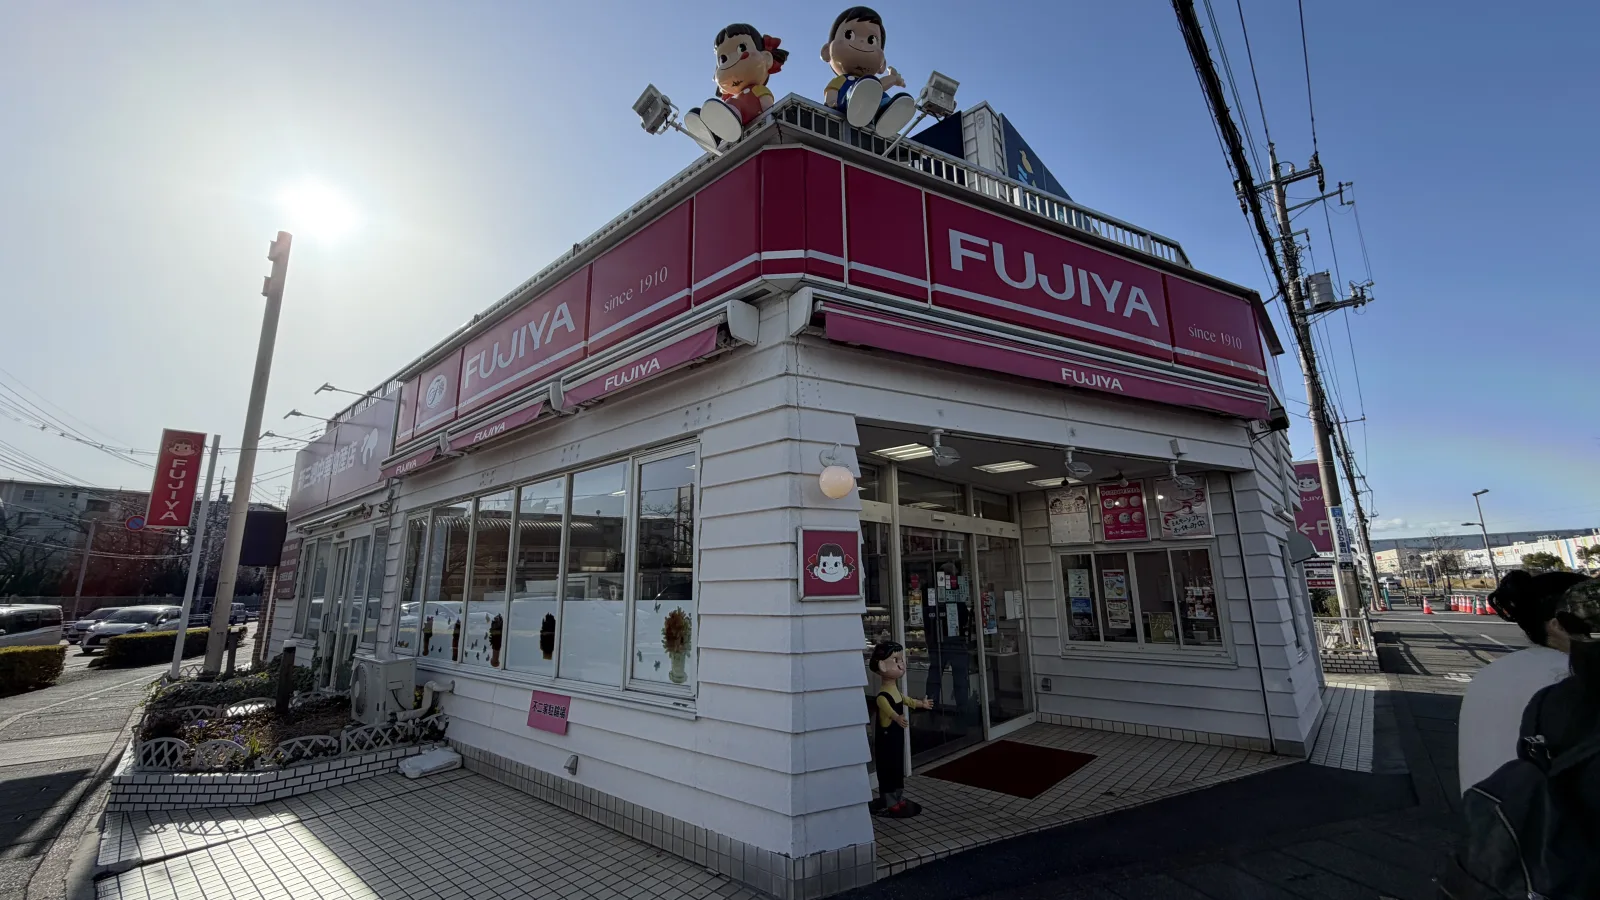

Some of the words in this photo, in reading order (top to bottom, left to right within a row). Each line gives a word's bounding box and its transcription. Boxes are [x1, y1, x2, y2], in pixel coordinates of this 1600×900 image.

[603, 287, 633, 314] since
[639, 266, 668, 294] 1910
[948, 228, 1160, 328] FUJIYA
[464, 301, 576, 389] FUJIYA
[1188, 323, 1217, 344] since
[1220, 331, 1242, 350] 1910
[604, 356, 661, 391] FUJIYA
[1061, 367, 1124, 392] FUJIYA
[473, 421, 506, 444] FUJIYA
[395, 457, 417, 476] FUJIYA
[158, 457, 188, 522] FUJIYA
